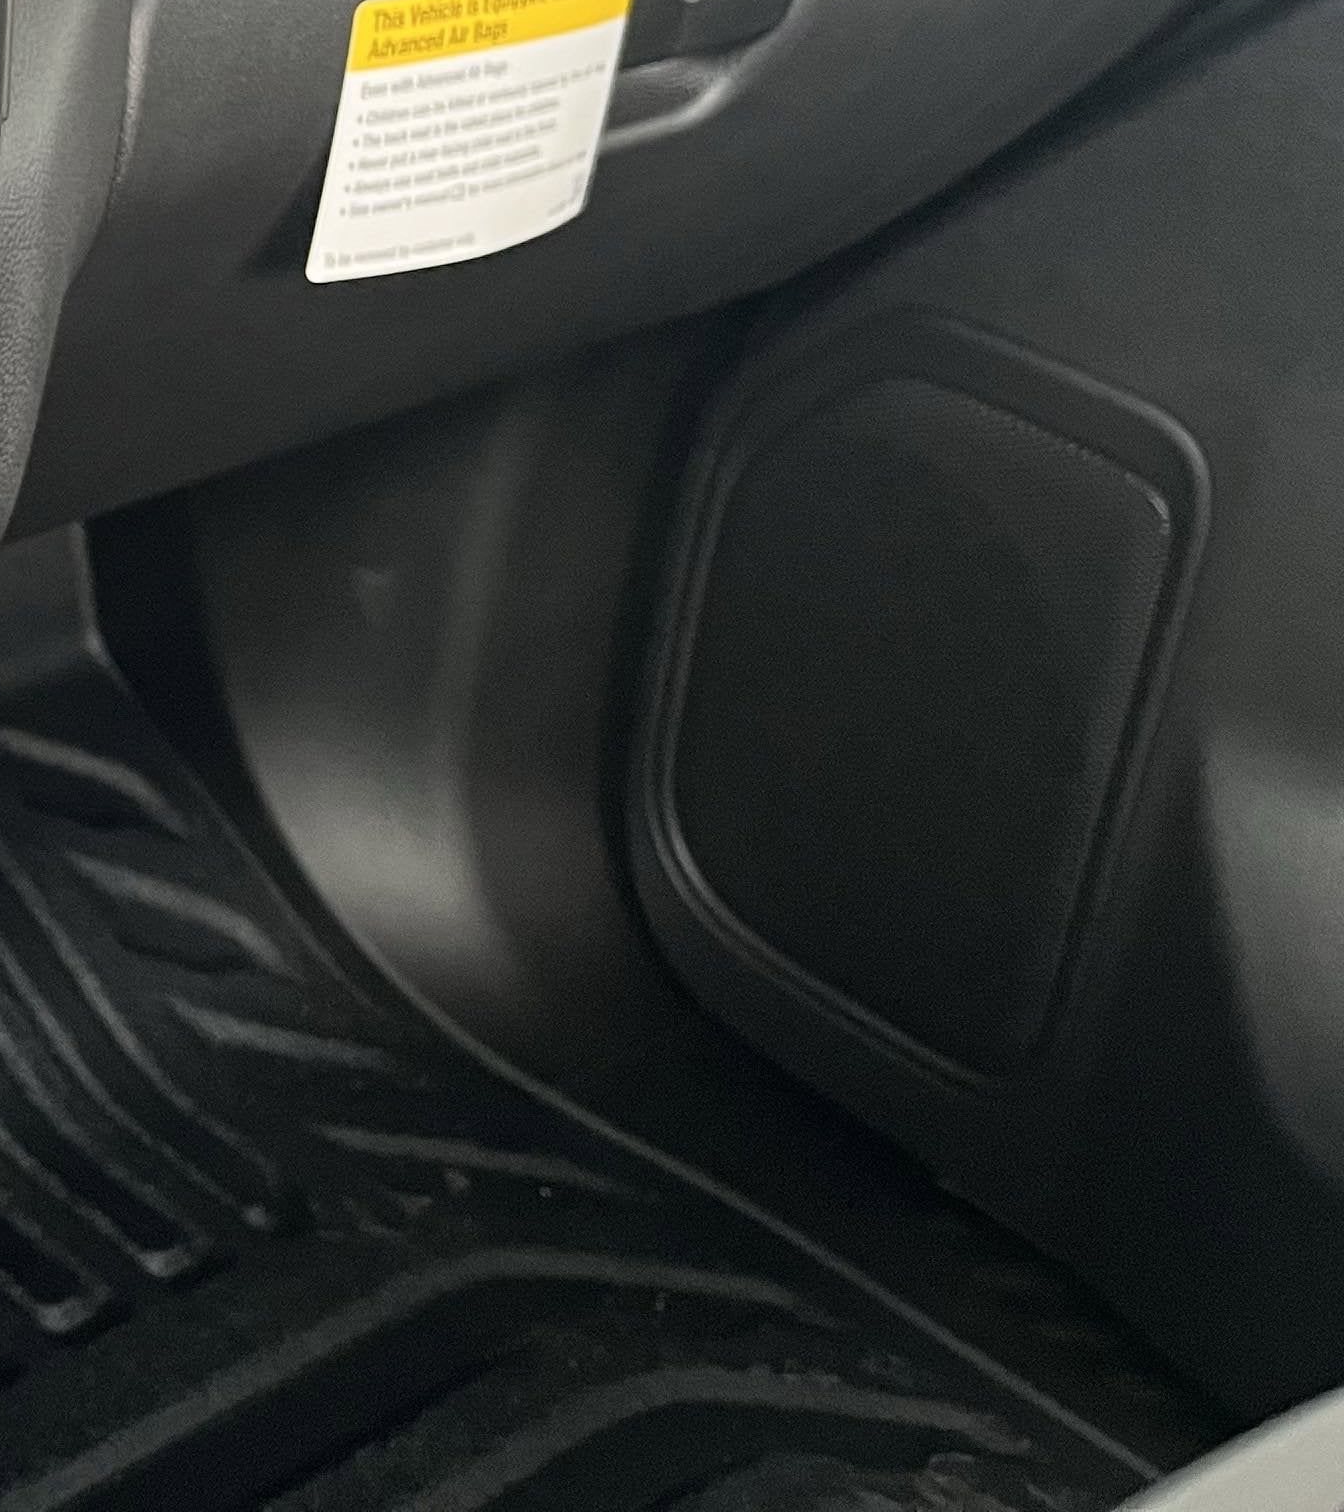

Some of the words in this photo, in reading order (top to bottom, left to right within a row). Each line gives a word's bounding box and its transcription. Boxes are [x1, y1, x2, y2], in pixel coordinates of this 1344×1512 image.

[374, 9, 405, 32] This
[411, 0, 462, 25] Vehicle
[367, 29, 444, 60] Advanced
